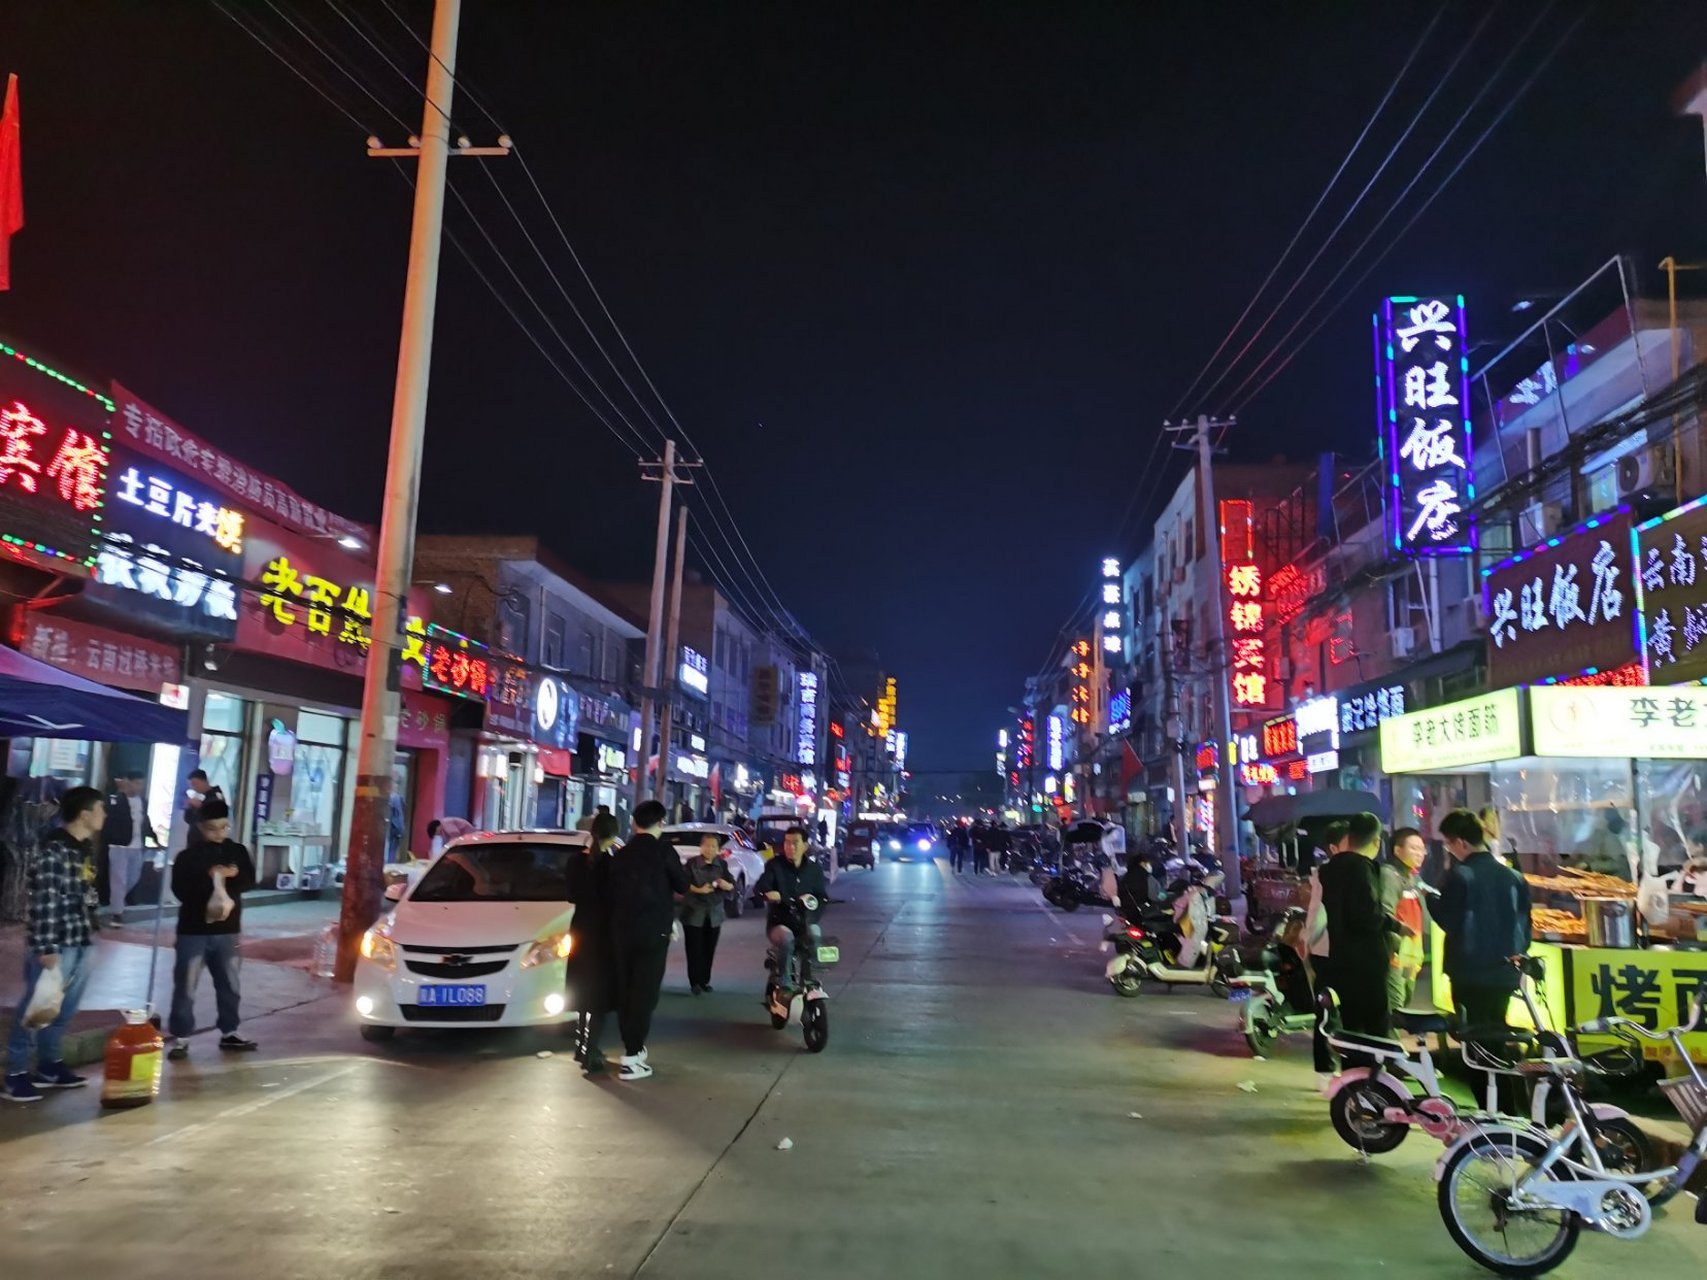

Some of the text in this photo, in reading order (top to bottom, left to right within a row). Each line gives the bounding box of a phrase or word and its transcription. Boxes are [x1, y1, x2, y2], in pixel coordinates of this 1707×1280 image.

[1395, 300, 1466, 543] 兴旺饭店
[1490, 540, 1623, 648] 兴旺饭店
[1642, 533, 1707, 592] 云南
[1629, 697, 1707, 728] 李老
